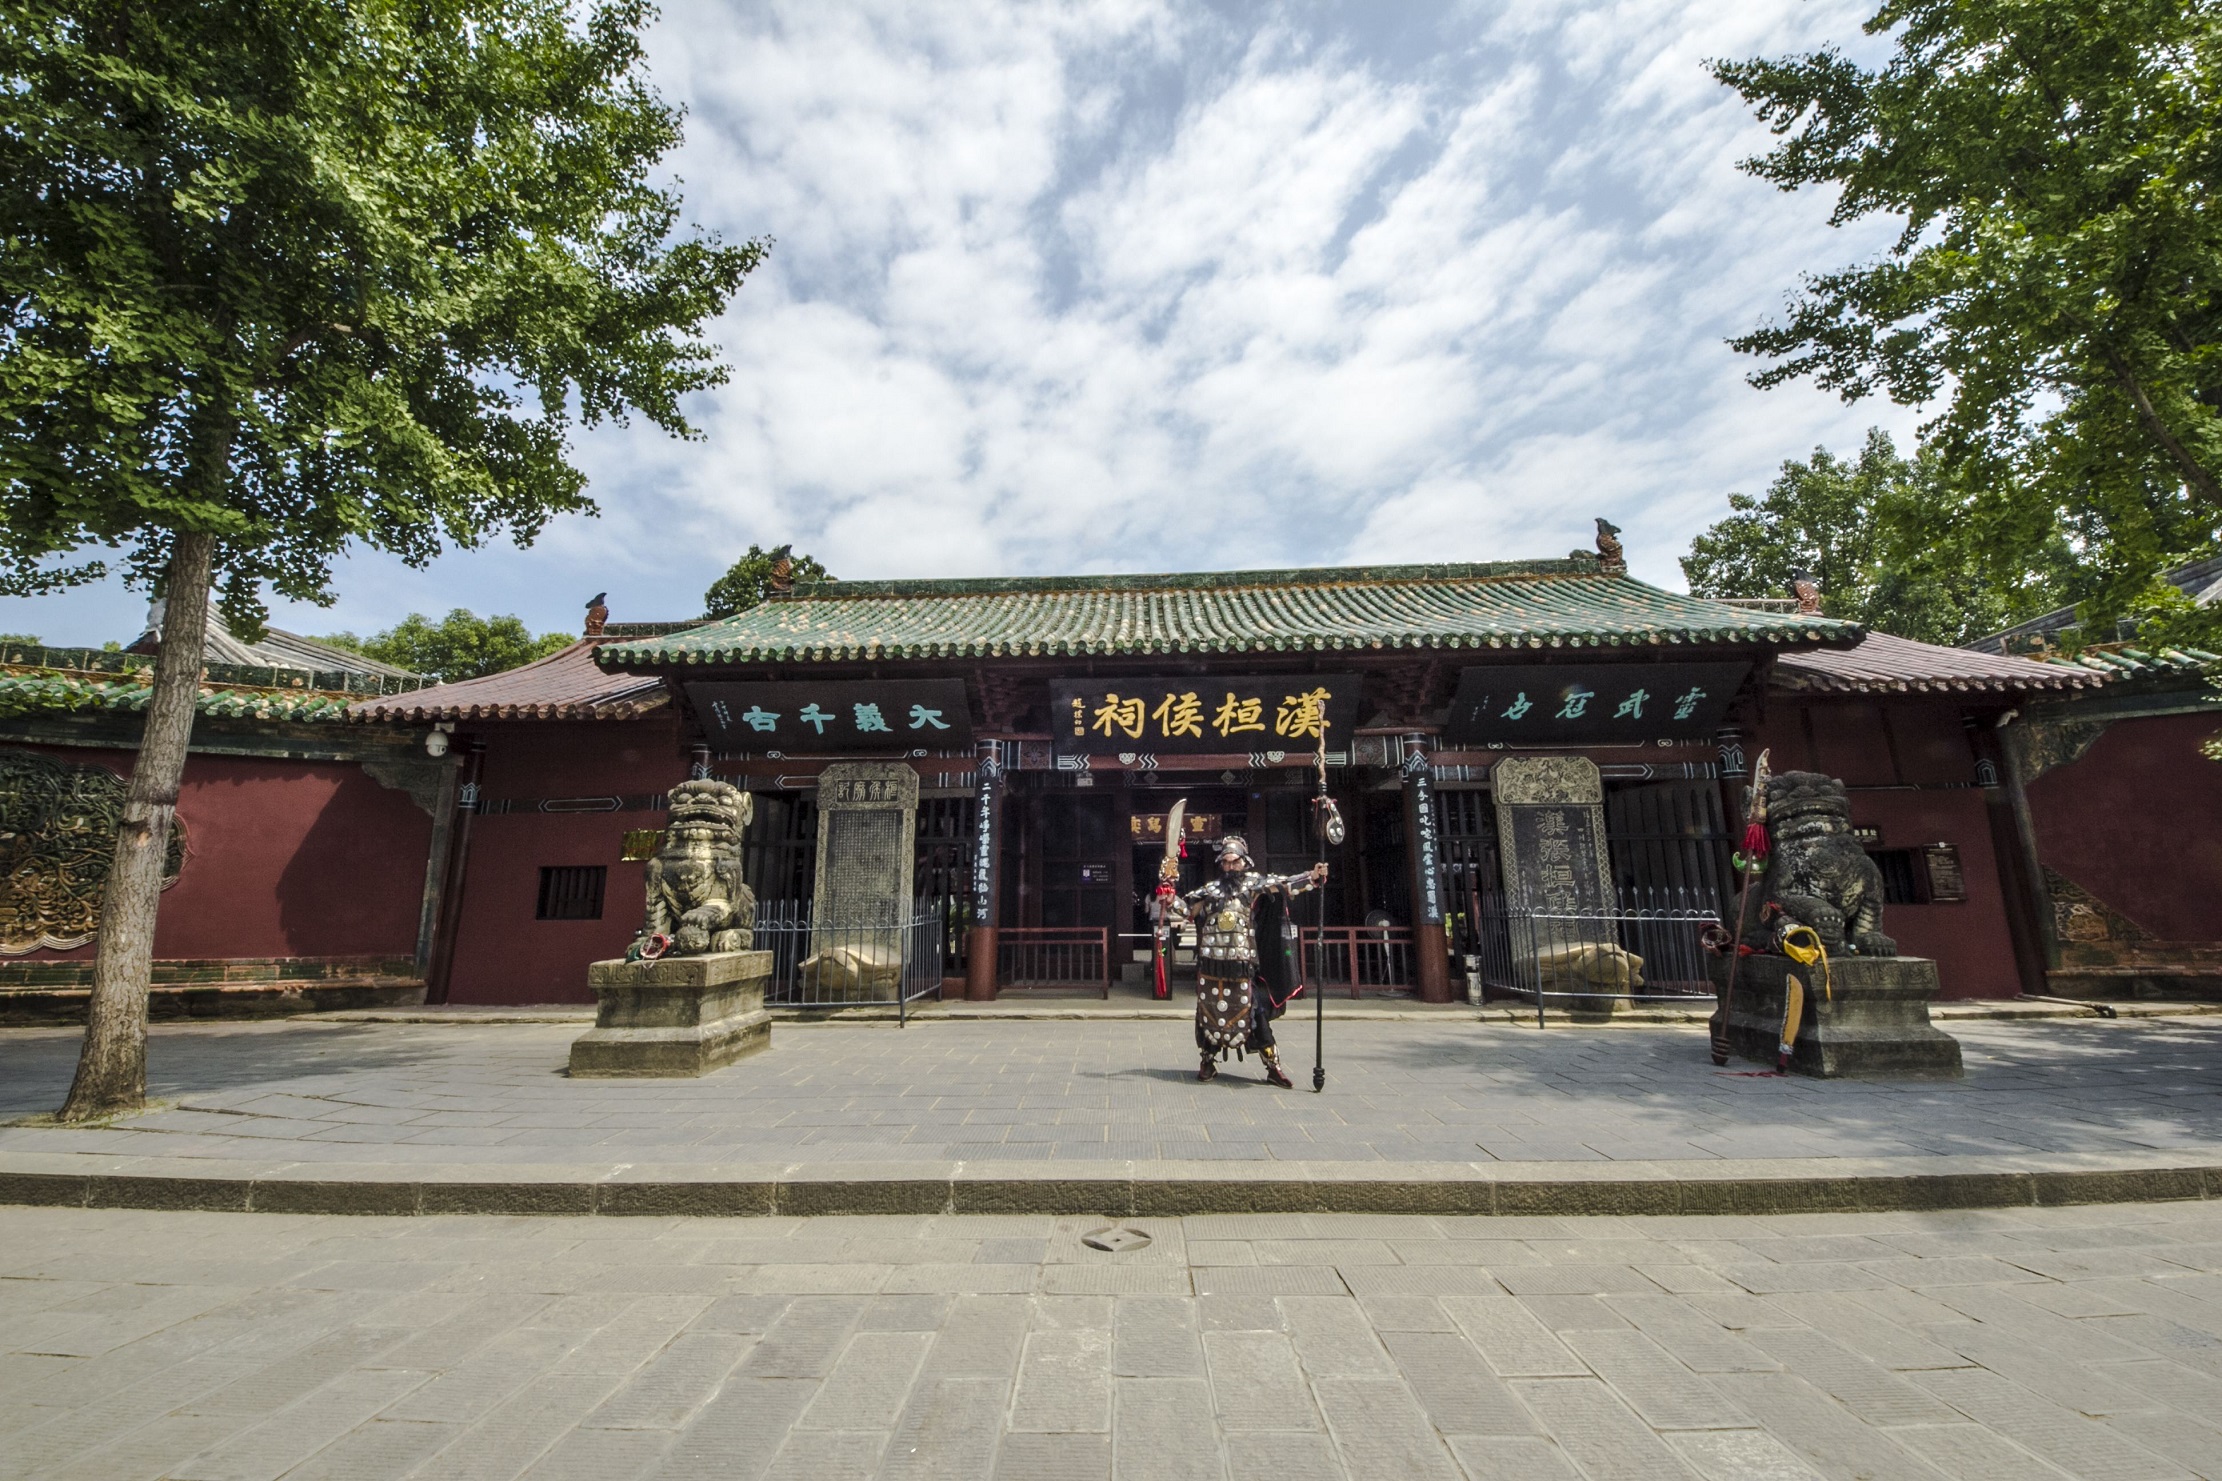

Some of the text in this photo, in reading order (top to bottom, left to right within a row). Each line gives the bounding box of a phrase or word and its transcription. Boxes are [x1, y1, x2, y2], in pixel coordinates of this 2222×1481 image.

[742, 702, 951, 735] 大義千古
[1092, 687, 1332, 739] 漢桓侯祠
